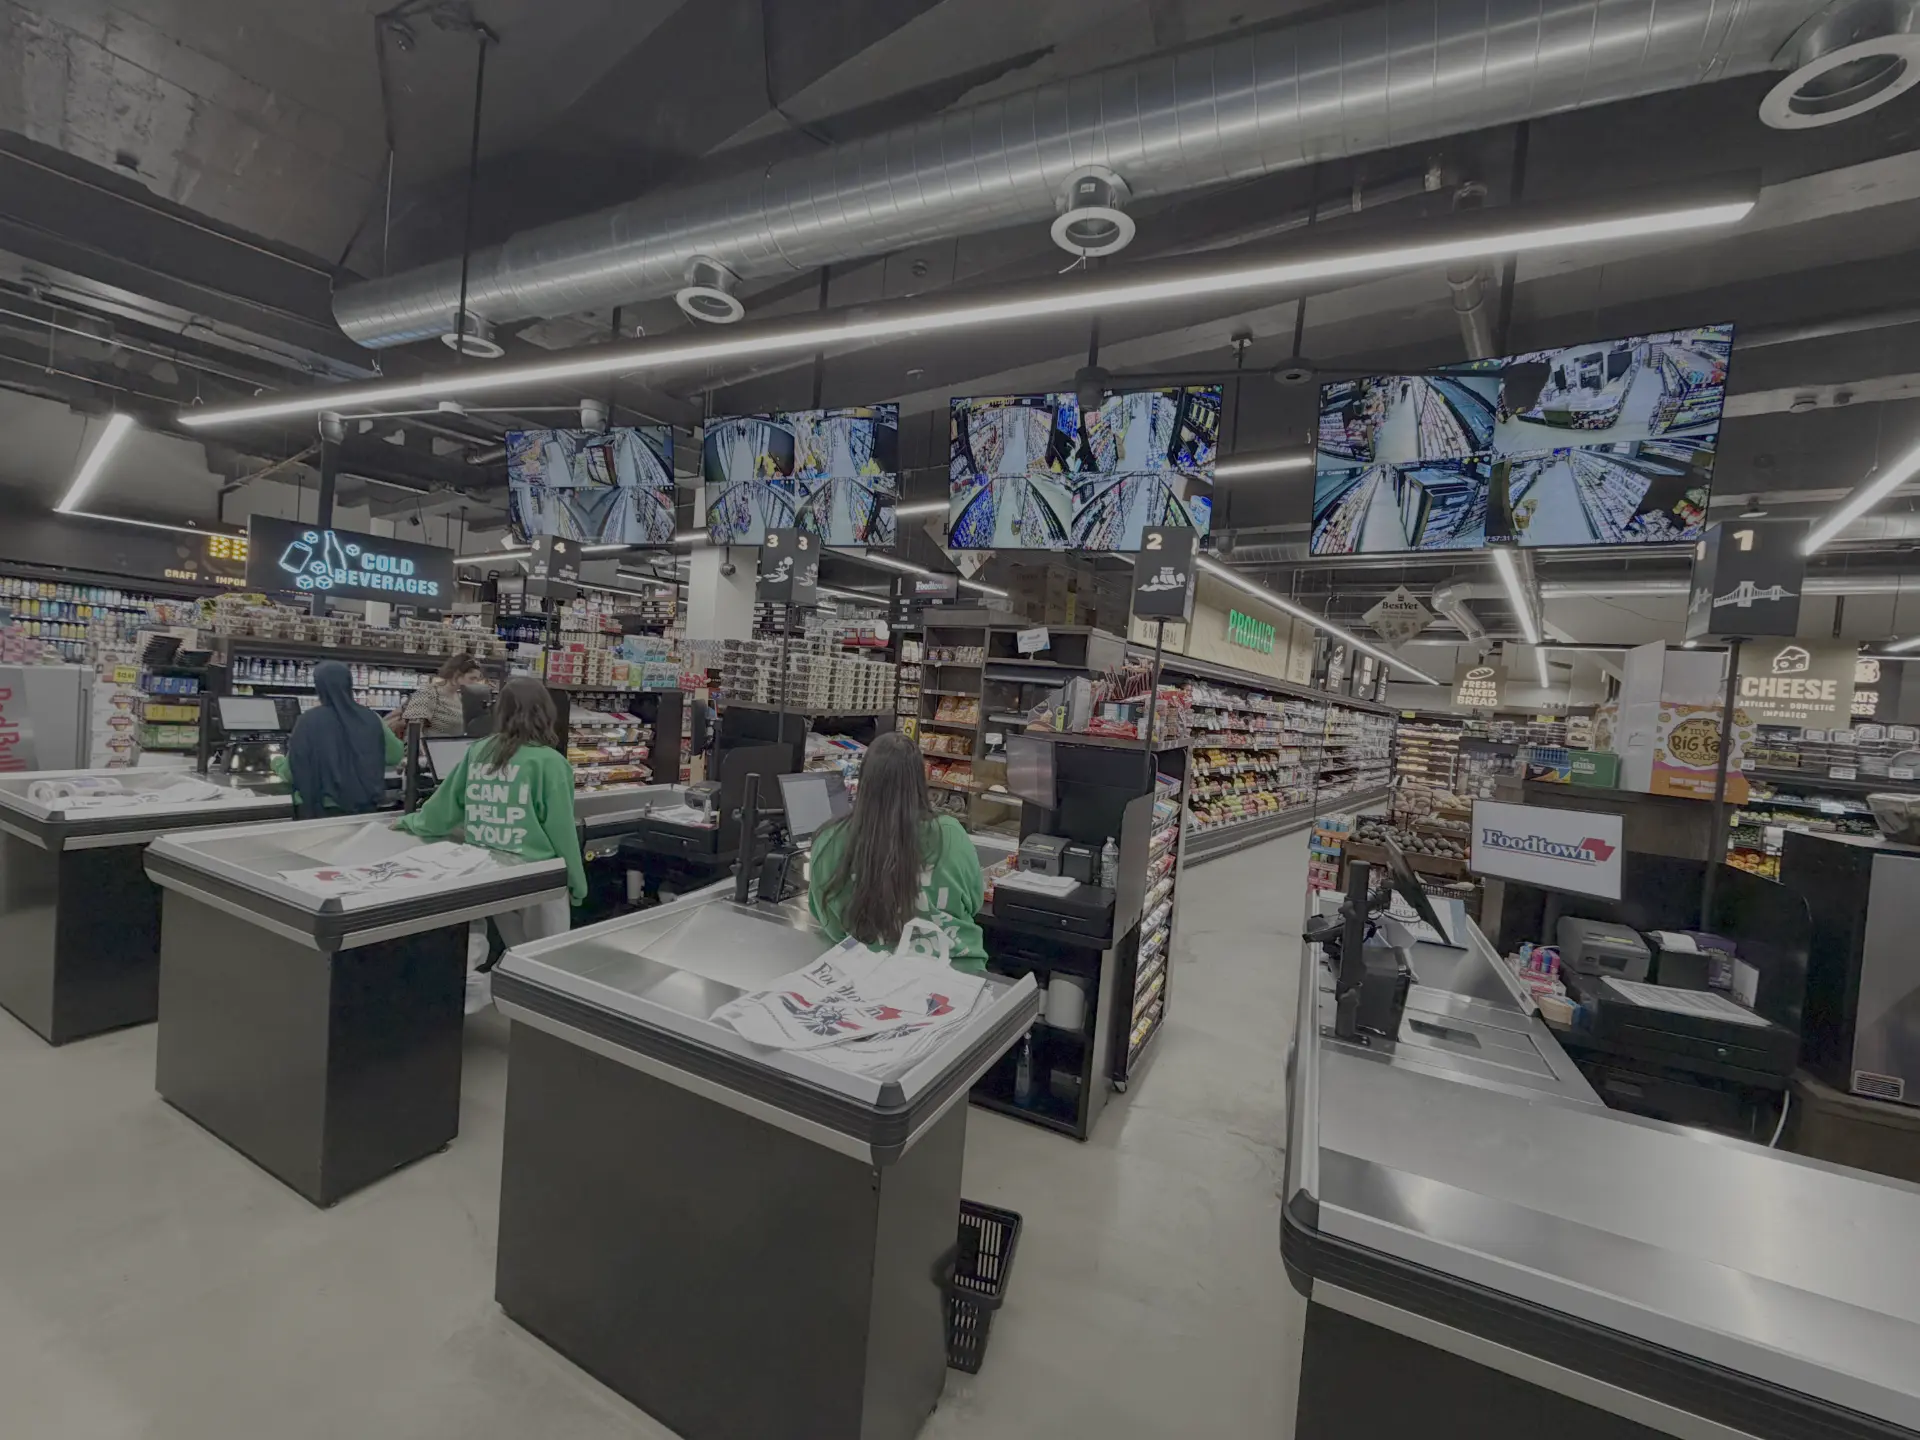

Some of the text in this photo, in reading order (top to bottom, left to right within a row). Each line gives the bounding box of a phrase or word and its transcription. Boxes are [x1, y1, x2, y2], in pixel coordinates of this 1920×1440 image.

[208, 535, 248, 561] BE
[531, 539, 541, 551] 4
[553, 541, 567, 554] 4
[766, 534, 779, 548] 3
[797, 536, 809, 551] 3
[1146, 533, 1163, 550] 2
[1732, 529, 1754, 551] 1
[1696, 540, 1707, 561] 1
[360, 552, 415, 576] COLD
[164, 568, 247, 587] CRAFT IMPOR
[333, 568, 439, 596] BEVERAGES
[1381, 601, 1419, 610] BestYet
[1142, 622, 1177, 646] & NAURAL
[1228, 608, 1276, 655] PRODUCE
[1459, 687, 1497, 698] BAKED
[1462, 680, 1496, 689] FRESH
[1740, 676, 1837, 701] CHEESE
[1456, 695, 1498, 707] BREAD
[1738, 700, 1836, 712] ARTISAN DOMESTIC
[1852, 691, 1880, 704] ATS
[1762, 710, 1808, 719] IMPORTED
[1850, 702, 1876, 715] SES
[1689, 727, 1711, 738] my
[1670, 735, 1721, 753] BiG fa
[1678, 751, 1719, 761] cookie
[468, 763, 520, 782] HOW
[466, 782, 530, 805] CAN I
[465, 803, 526, 825] HELP
[466, 824, 528, 845] YOU?
[1482, 828, 1597, 862] Foodtown
